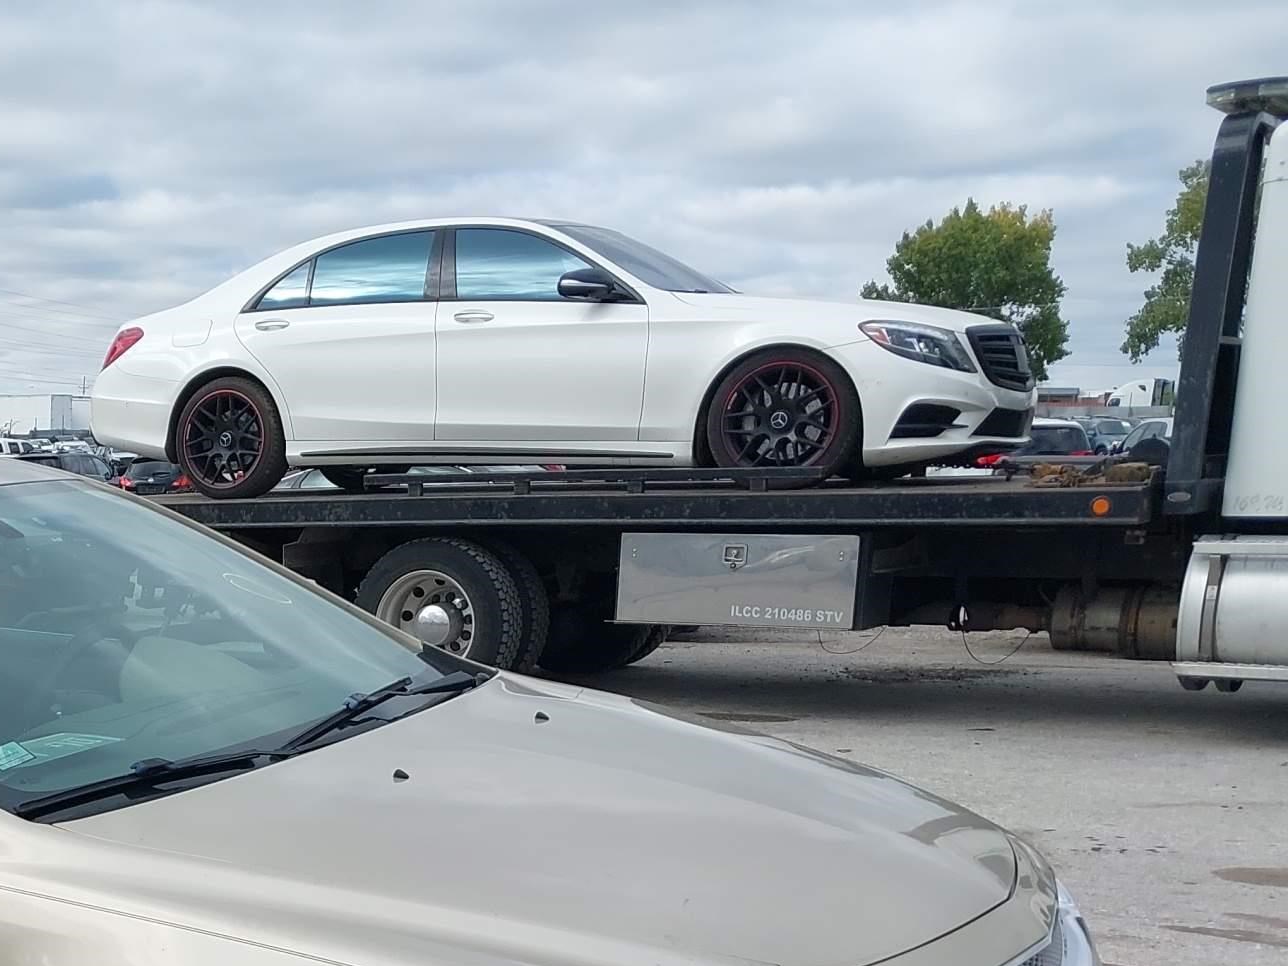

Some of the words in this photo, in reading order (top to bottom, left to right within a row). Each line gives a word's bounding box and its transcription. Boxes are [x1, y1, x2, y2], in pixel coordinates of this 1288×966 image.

[730, 604, 761, 618] ILCC
[764, 607, 812, 621] 210486
[815, 609, 844, 623] STV
